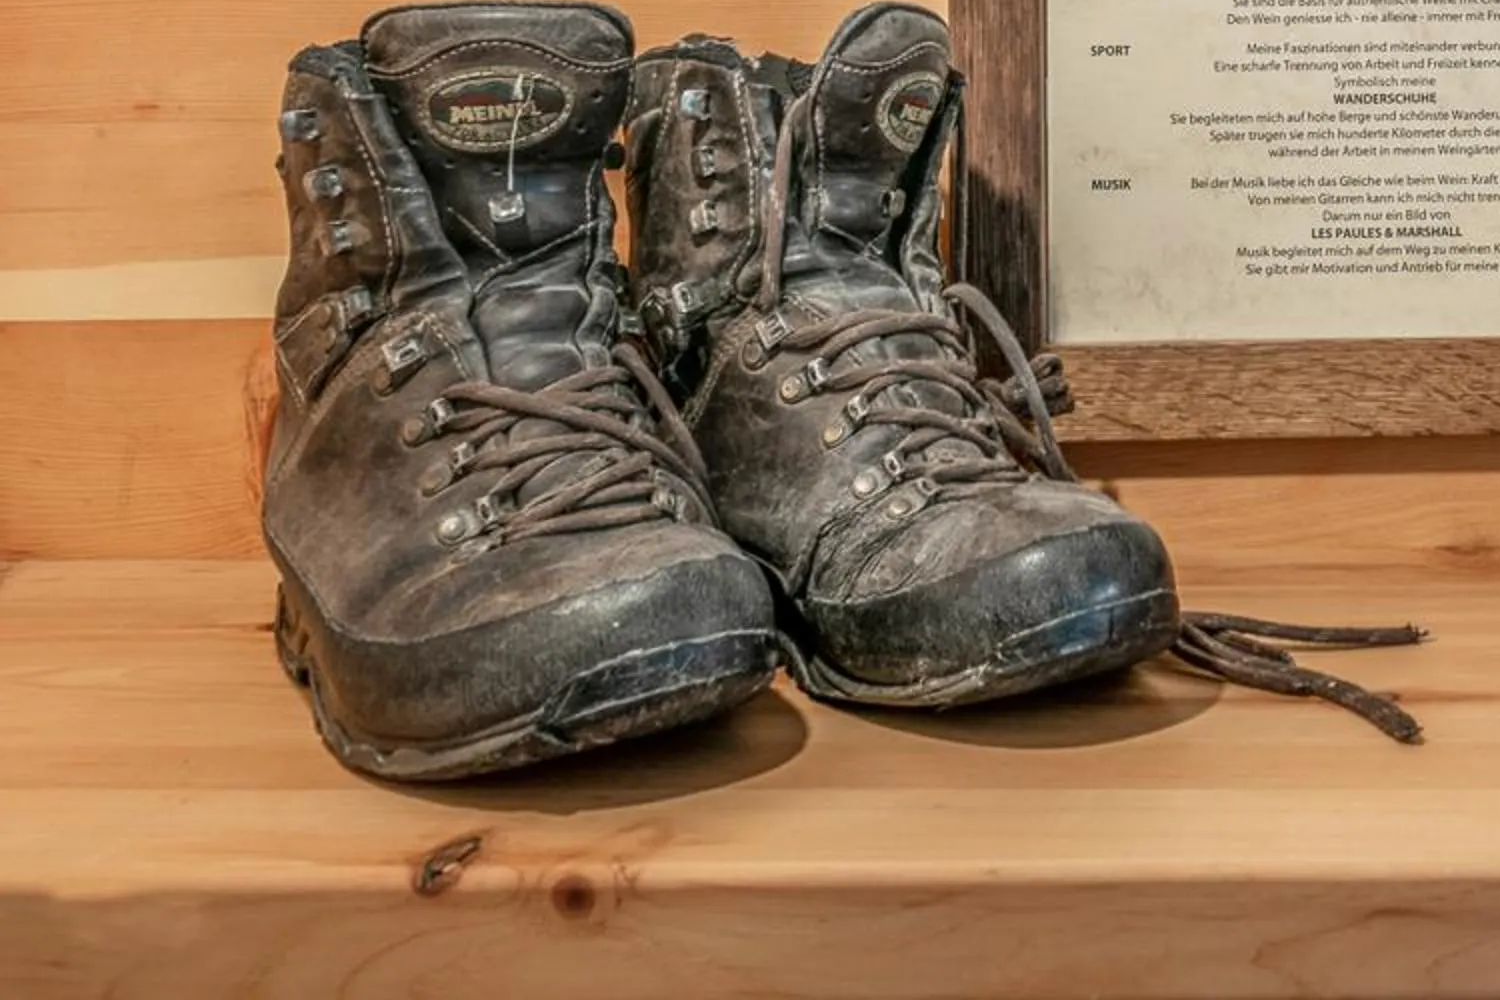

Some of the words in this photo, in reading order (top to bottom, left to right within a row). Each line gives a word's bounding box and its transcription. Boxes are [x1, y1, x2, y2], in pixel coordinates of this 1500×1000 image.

[1227, 12, 1250, 24] Den
[1252, 12, 1280, 24] Wein
[1284, 11, 1332, 27] geniesse
[1335, 11, 1352, 23] ich
[1362, 11, 1378, 23] nie
[1381, 11, 1417, 22] alleine
[1427, 10, 1463, 22] immer
[1466, 10, 1484, 22] mit
[1091, 45, 1131, 56] SPORT
[1247, 42, 1281, 54] Meine
[1284, 41, 1361, 53] Faszinationen
[1365, 41, 1388, 53] sind
[1391, 40, 1458, 52] miteinander
[1214, 59, 1238, 71] Eine
[1241, 59, 1281, 71] scharfe
[1284, 58, 1338, 74] Trennung
[1341, 61, 1363, 70] von
[1364, 58, 1400, 69] Arbeit
[1402, 57, 1425, 69] und
[1427, 57, 1468, 69] Freizeit
[1335, 75, 1399, 91] Symbolisch
[1401, 75, 1436, 87] meine
[1334, 92, 1437, 104] WANDERSCHUHE
[1171, 112, 1187, 123] Sie
[1190, 111, 1254, 126] begleiteten
[1257, 111, 1285, 122] mich
[1287, 111, 1305, 122] auf
[1307, 110, 1336, 122] hohe
[1374, 110, 1397, 121] und
[1210, 128, 1245, 143] Später
[1249, 129, 1287, 143] trugen
[1289, 128, 1304, 139] sie
[1307, 127, 1335, 139] mich
[1338, 127, 1389, 139] hunderte
[1392, 126, 1447, 138] Kilometer
[1448, 126, 1482, 138] durch
[1484, 126, 1500, 137] die
[1269, 145, 1319, 157] während
[1321, 145, 1339, 156] der
[1343, 144, 1376, 156] Arbeit
[1380, 144, 1390, 156] in
[1393, 144, 1435, 156] meinen
[1091, 179, 1131, 190] MUSIK
[1191, 176, 1209, 188] Bei
[1210, 176, 1229, 188] der
[1232, 176, 1265, 188] Musik
[1268, 176, 1296, 187] liebe
[1298, 175, 1315, 187] ich
[1318, 175, 1338, 187] das
[1339, 175, 1382, 187] Gleiche
[1385, 175, 1404, 186] wie
[1407, 174, 1435, 186] beim
[1472, 174, 1498, 186] Kraft
[1248, 193, 1270, 205] Von
[1274, 193, 1316, 204] meinen
[1318, 192, 1364, 204] Gitarren
[1366, 192, 1394, 203] kann
[1398, 192, 1414, 203] ich
[1417, 191, 1444, 203] mich
[1447, 191, 1475, 203] nicht
[1323, 210, 1361, 221] Darum
[1364, 212, 1383, 221] nur
[1386, 209, 1403, 221] ein
[1406, 209, 1427, 221] Bild
[1429, 212, 1450, 220] von
[1312, 227, 1333, 239] LES
[1336, 226, 1382, 238] PAULES
[1385, 226, 1393, 238] &
[1397, 226, 1463, 238] MARSHALL
[1237, 245, 1270, 257] Musik
[1272, 245, 1323, 260] begleitet
[1326, 245, 1353, 256] mich
[1357, 244, 1374, 256] auf
[1377, 244, 1403, 256] dem
[1404, 244, 1431, 259] Weg
[1433, 247, 1446, 255] zu
[1449, 243, 1492, 255] meinen
[1246, 262, 1263, 274] Sie
[1265, 262, 1288, 277] gibt
[1291, 262, 1310, 274] mir
[1312, 262, 1373, 273] Motivation
[1376, 261, 1399, 273] und
[1401, 261, 1443, 273] Antrieb
[1446, 261, 1461, 272] für
[1464, 260, 1499, 272] meine
